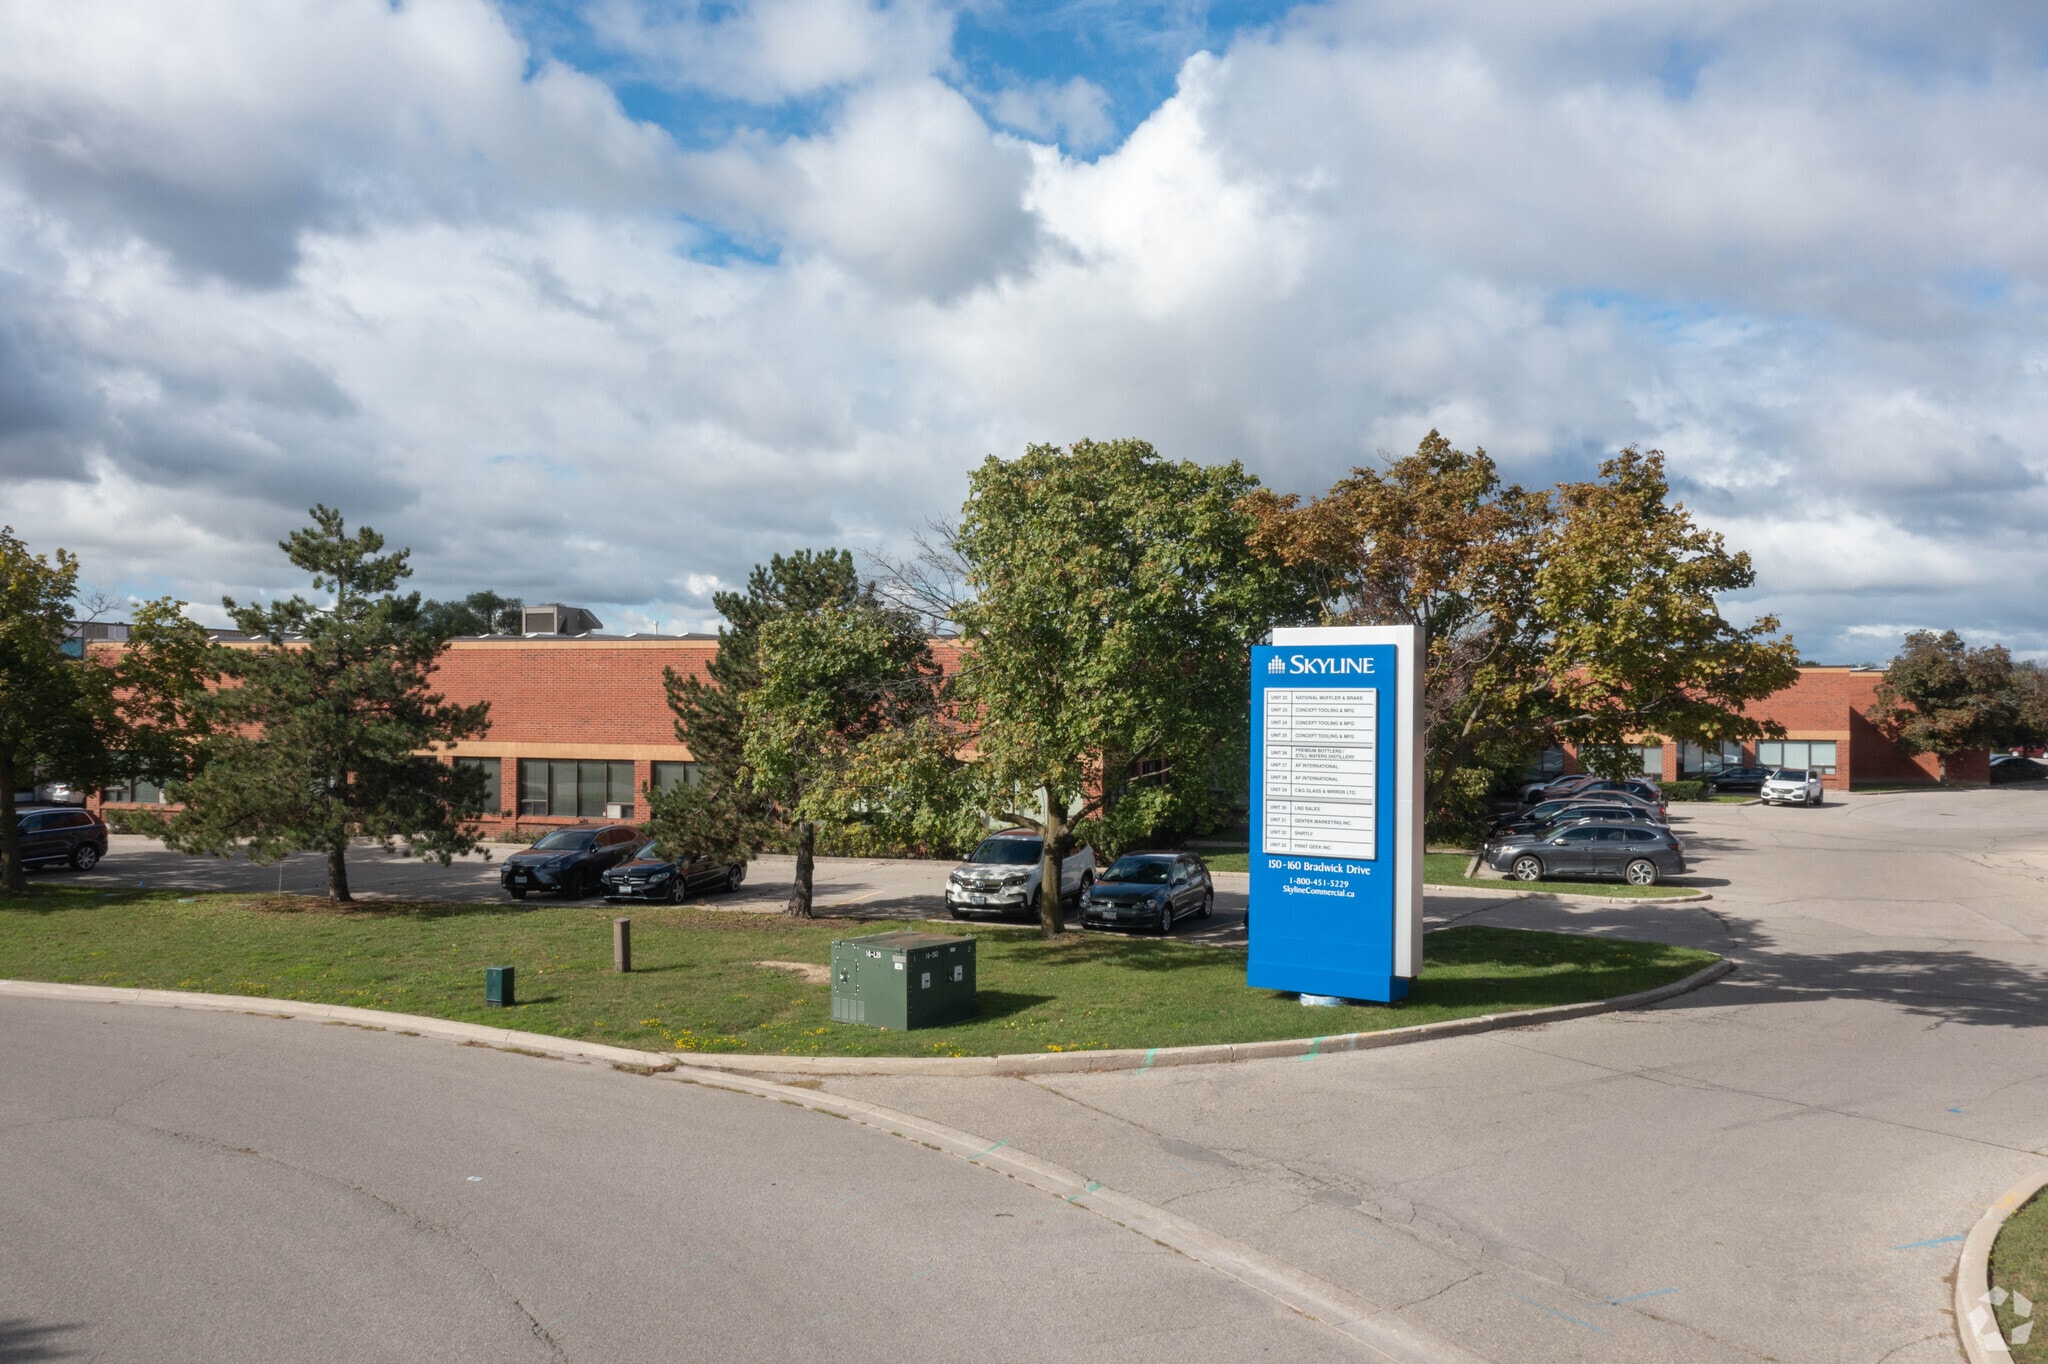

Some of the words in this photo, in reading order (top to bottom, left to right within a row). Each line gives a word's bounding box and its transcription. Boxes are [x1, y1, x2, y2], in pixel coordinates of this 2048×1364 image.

[1304, 861, 1343, 873] Bradwick
[1346, 865, 1371, 875] Drive
[1289, 877, 1349, 888] 1-800-451-5229
[1283, 885, 1355, 898] SkylineCommercial.ca
